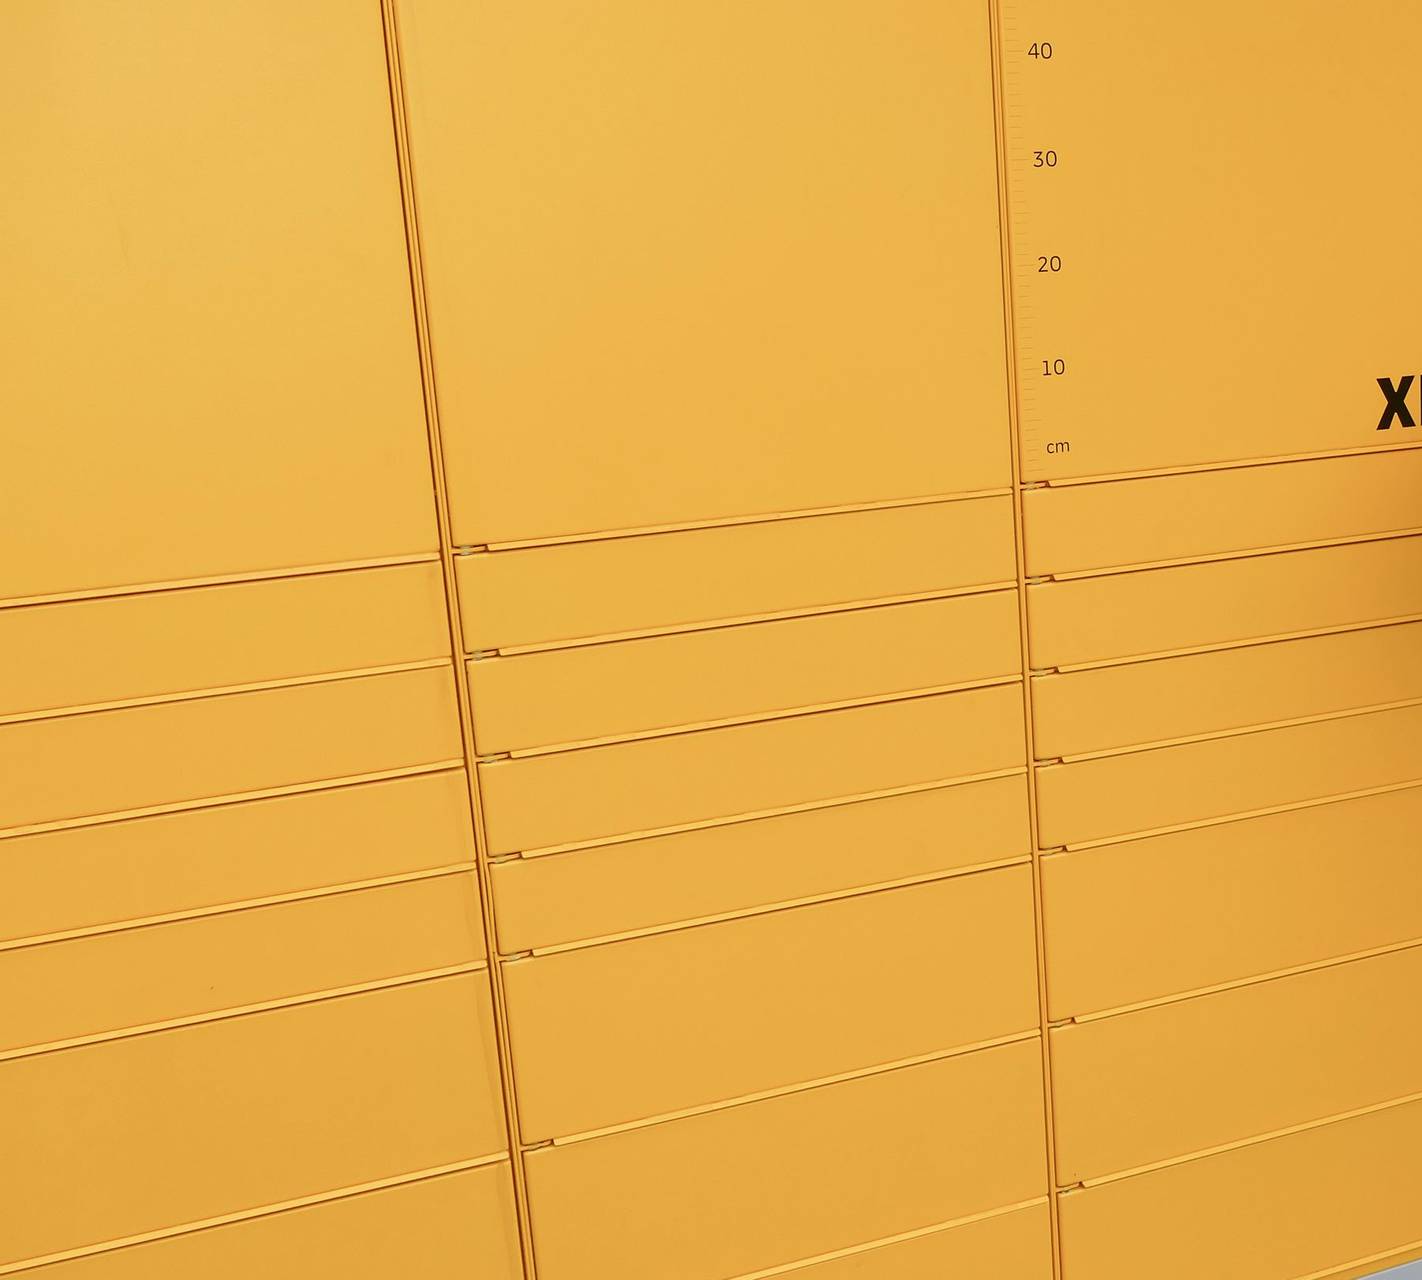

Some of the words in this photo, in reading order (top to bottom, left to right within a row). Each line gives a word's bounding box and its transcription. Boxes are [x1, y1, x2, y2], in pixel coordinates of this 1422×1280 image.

[1028, 42, 1052, 59] 40
[1033, 150, 1057, 168] 30
[1038, 255, 1062, 273] 20
[1042, 359, 1065, 376] 10
[1046, 441, 1070, 454] cm
